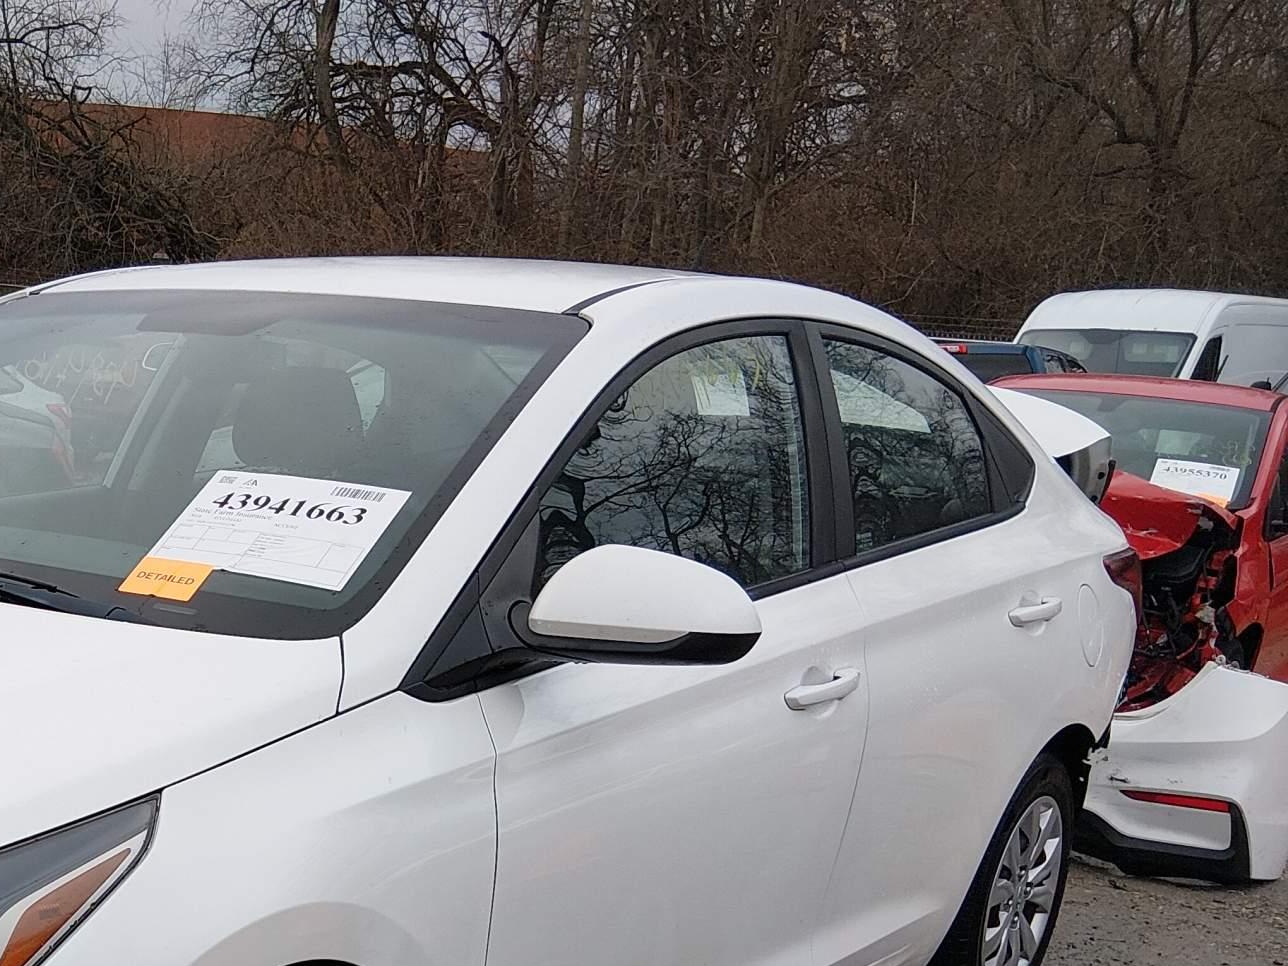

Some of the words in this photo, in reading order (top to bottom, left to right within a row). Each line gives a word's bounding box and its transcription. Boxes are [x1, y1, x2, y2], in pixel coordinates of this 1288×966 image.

[1162, 466, 1228, 480] 43955370
[212, 491, 368, 525] 43941663
[214, 508, 234, 516] Farm
[236, 511, 274, 520] Insurance
[136, 571, 195, 586] DETAILED
